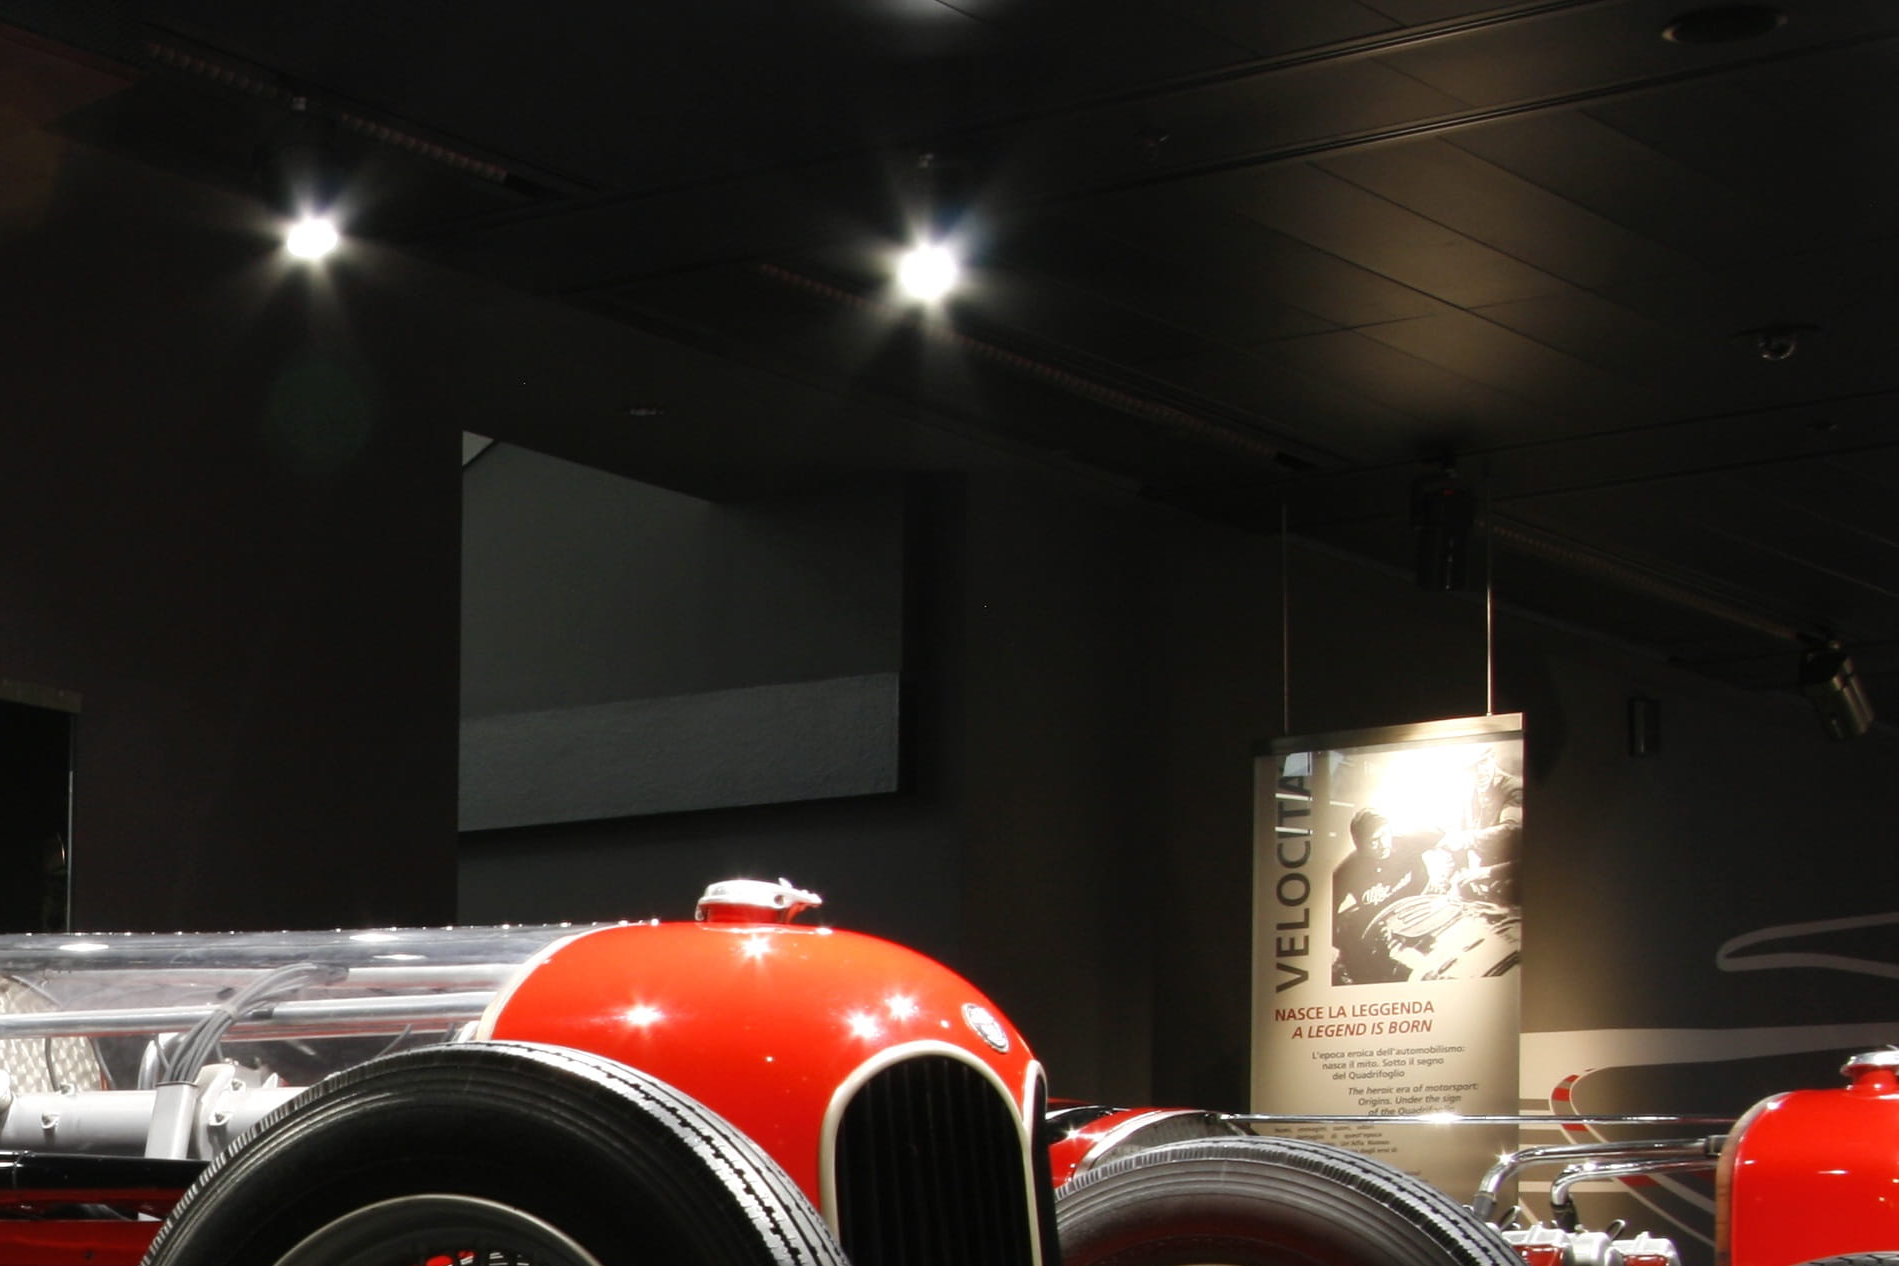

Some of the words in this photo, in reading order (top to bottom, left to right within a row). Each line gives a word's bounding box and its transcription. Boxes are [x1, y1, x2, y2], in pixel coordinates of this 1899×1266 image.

[1275, 1007, 1323, 1021] NASCE
[1328, 1005, 1347, 1018] LA
[1352, 1001, 1435, 1017] LEGGENDA
[1291, 1026, 1303, 1039] A
[1307, 1023, 1367, 1038] LEGEND
[1371, 1022, 1384, 1035] IS
[1388, 1019, 1433, 1034] BORN
[1312, 1051, 1345, 1060] L'epoca
[1347, 1050, 1374, 1058] eroica
[1349, 1060, 1354, 1069] il
[1357, 1059, 1379, 1068] mito.
[1382, 1059, 1406, 1067] Sotto
[1416, 1057, 1444, 1067] segno
[1332, 1072, 1346, 1080] del
[1348, 1070, 1405, 1080] Quadrifoglio
[1348, 1087, 1364, 1095] The
[1366, 1086, 1393, 1095] heroic
[1413, 1084, 1423, 1092] of
[1358, 1097, 1392, 1106] Origins.
[1395, 1096, 1423, 1104] Under
[1425, 1095, 1441, 1103] the
[1442, 1094, 1462, 1104] sign
[1368, 1108, 1379, 1116] of
[1381, 1107, 1396, 1116] the
